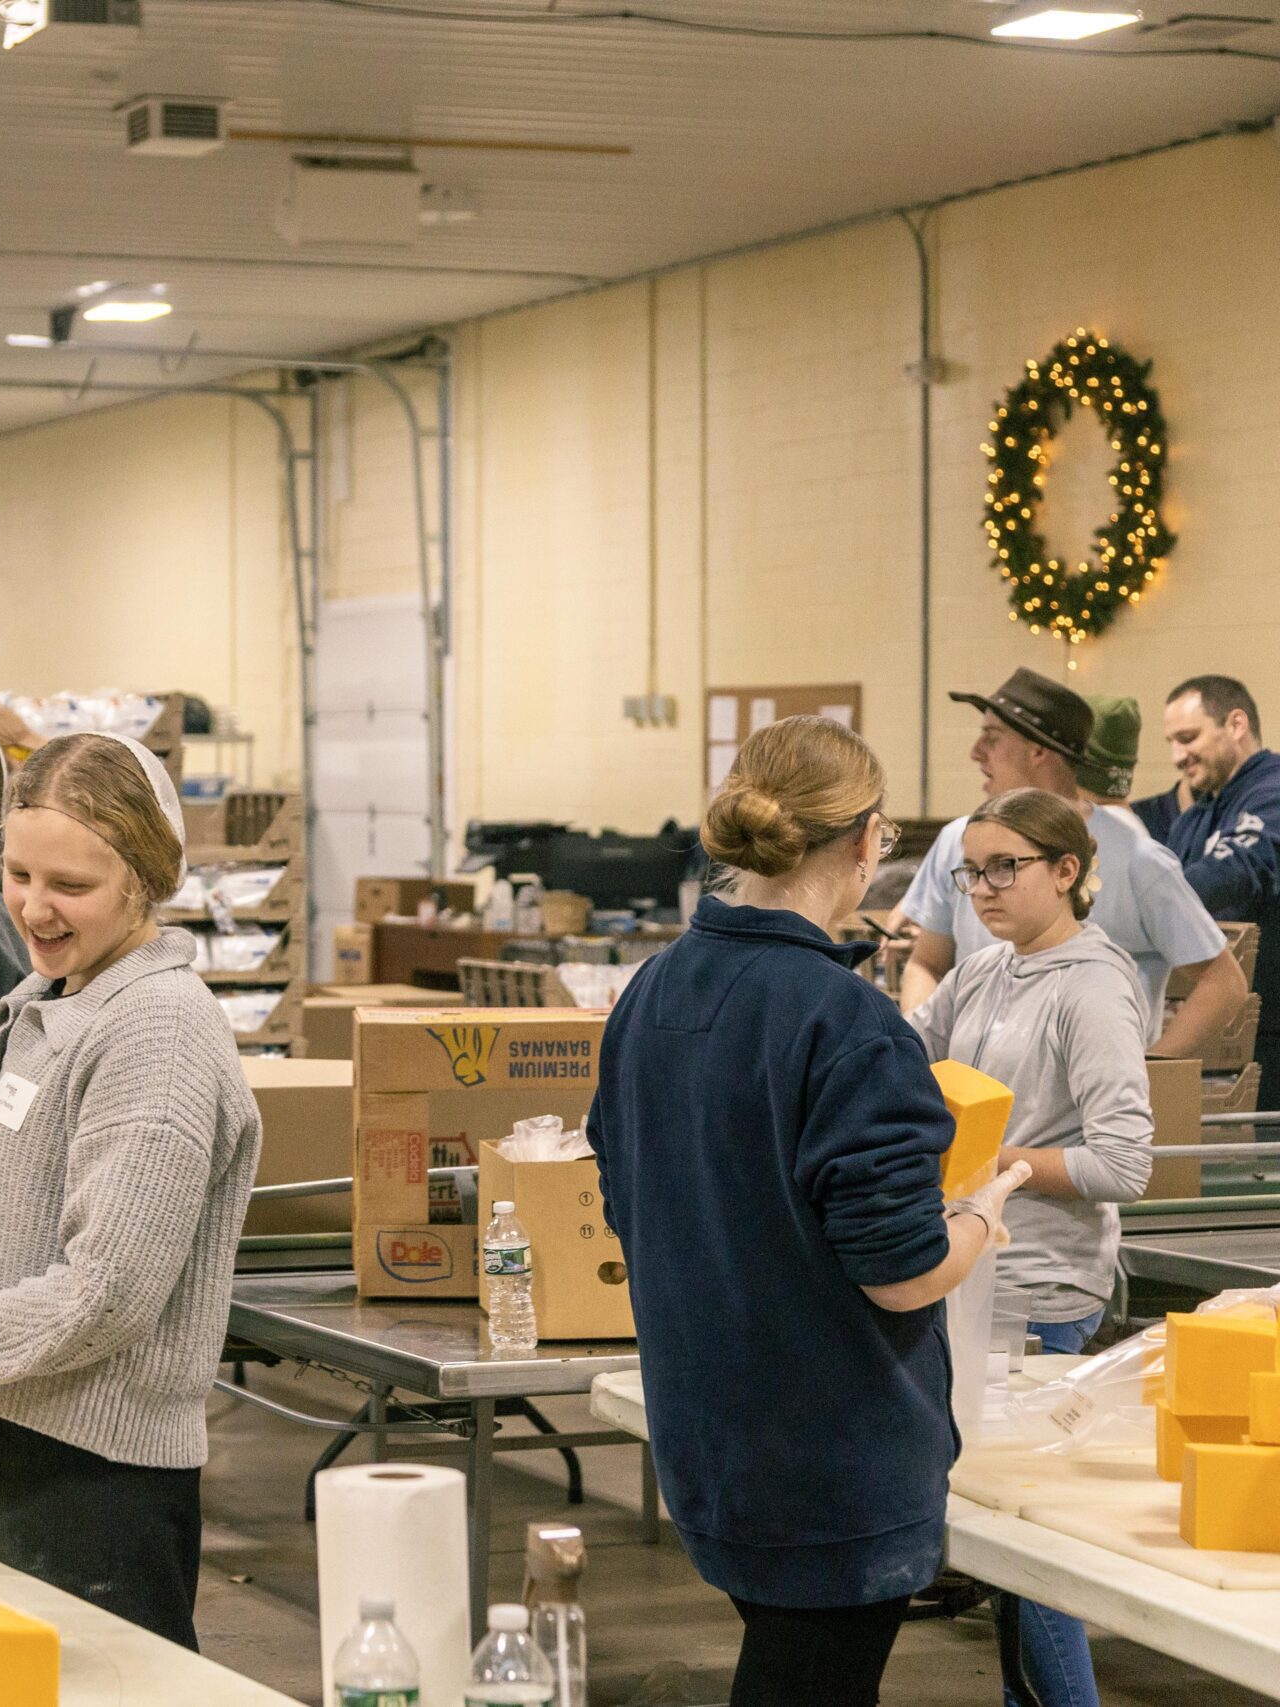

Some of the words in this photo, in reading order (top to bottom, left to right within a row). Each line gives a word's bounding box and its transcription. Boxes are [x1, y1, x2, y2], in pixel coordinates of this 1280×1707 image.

[508, 1039, 591, 1058] BANANAS
[508, 1061, 591, 1079] PREMIUM
[391, 1241, 443, 1263] Dole
